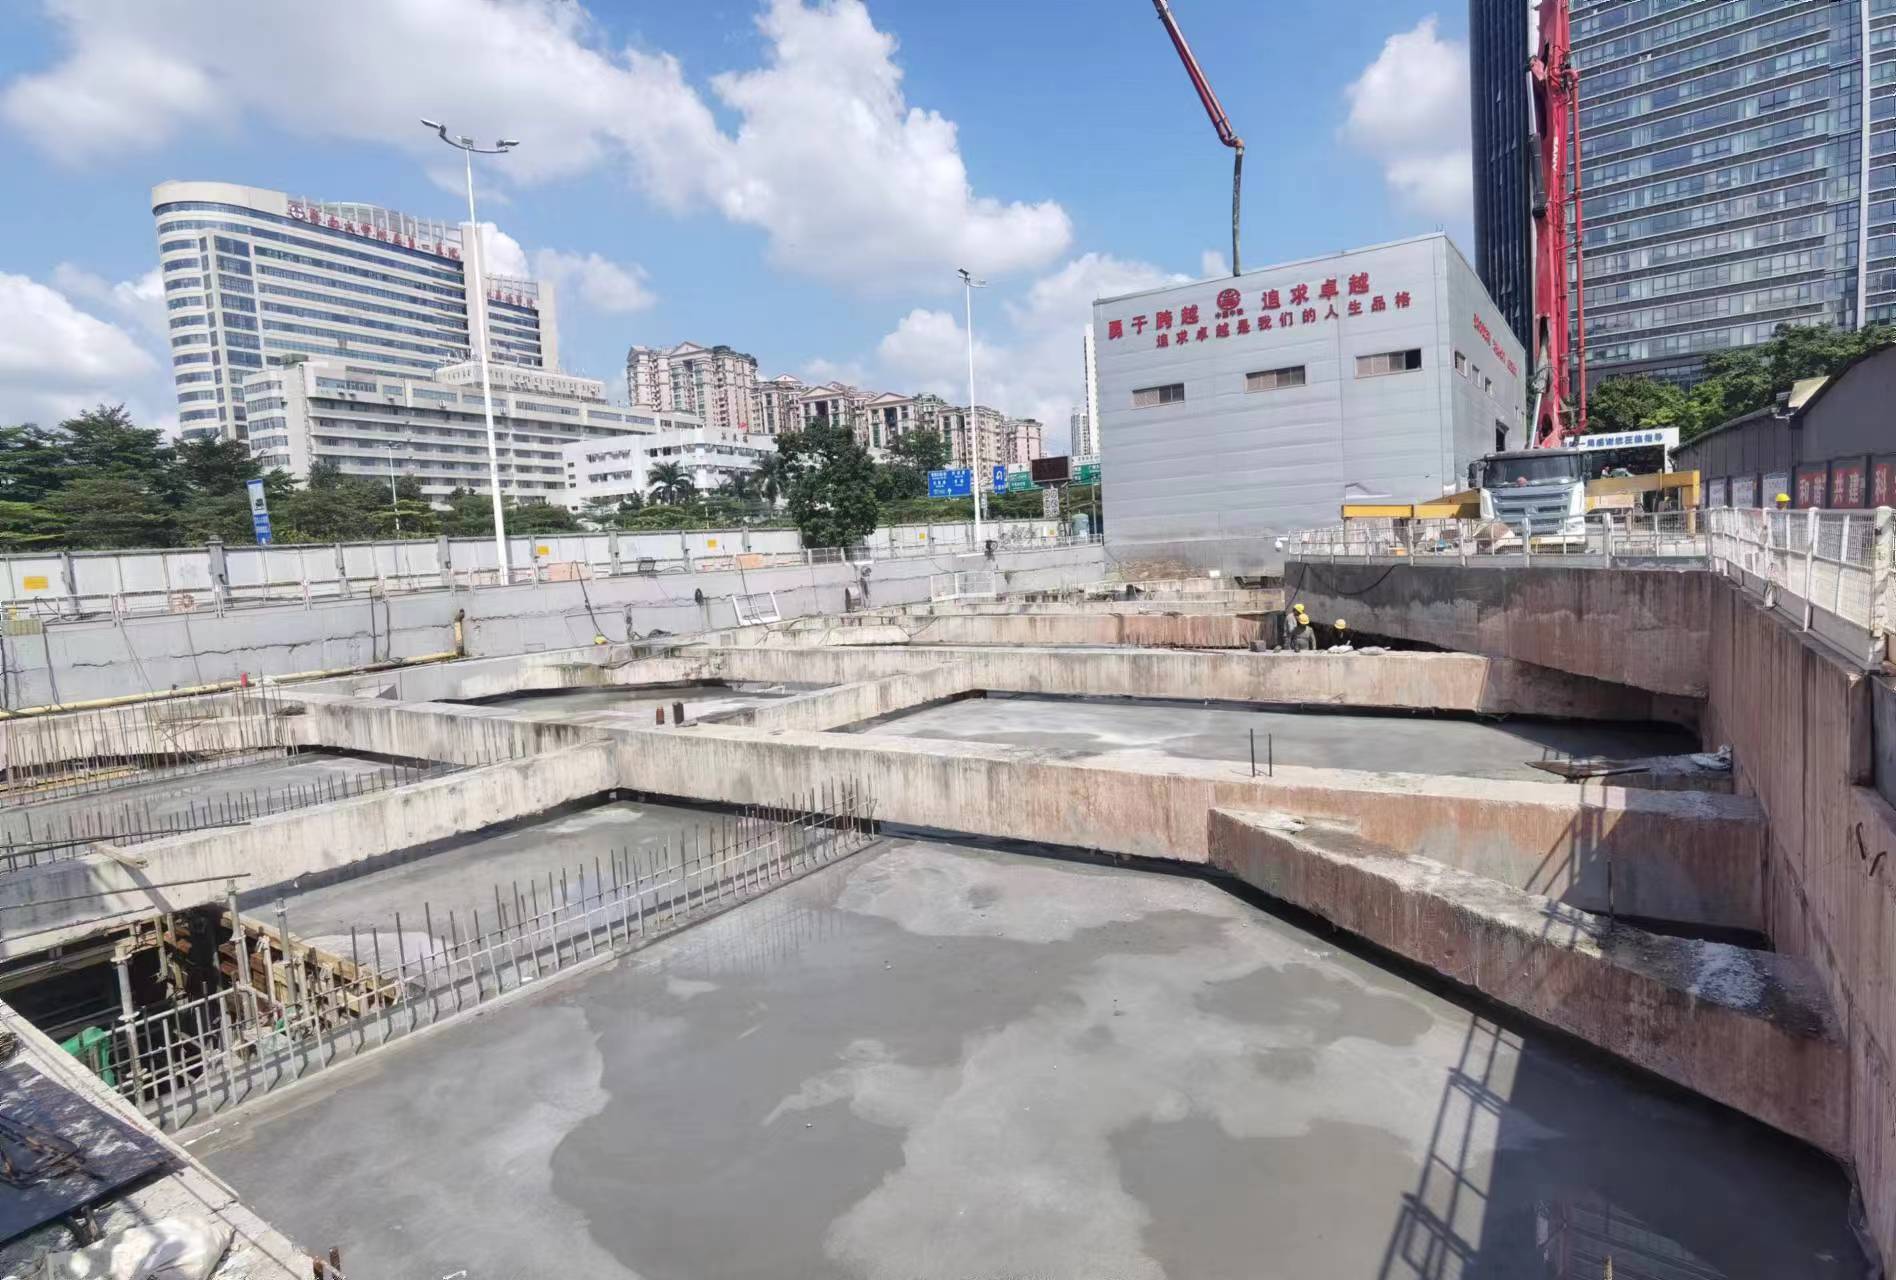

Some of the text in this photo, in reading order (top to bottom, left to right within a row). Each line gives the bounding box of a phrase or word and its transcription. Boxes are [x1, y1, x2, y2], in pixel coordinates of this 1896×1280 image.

[1261, 272, 1370, 311] 追求卓越
[1108, 304, 1200, 341] 勇于跨越
[1156, 291, 1411, 348] 追求卓越是我们的人生品格
